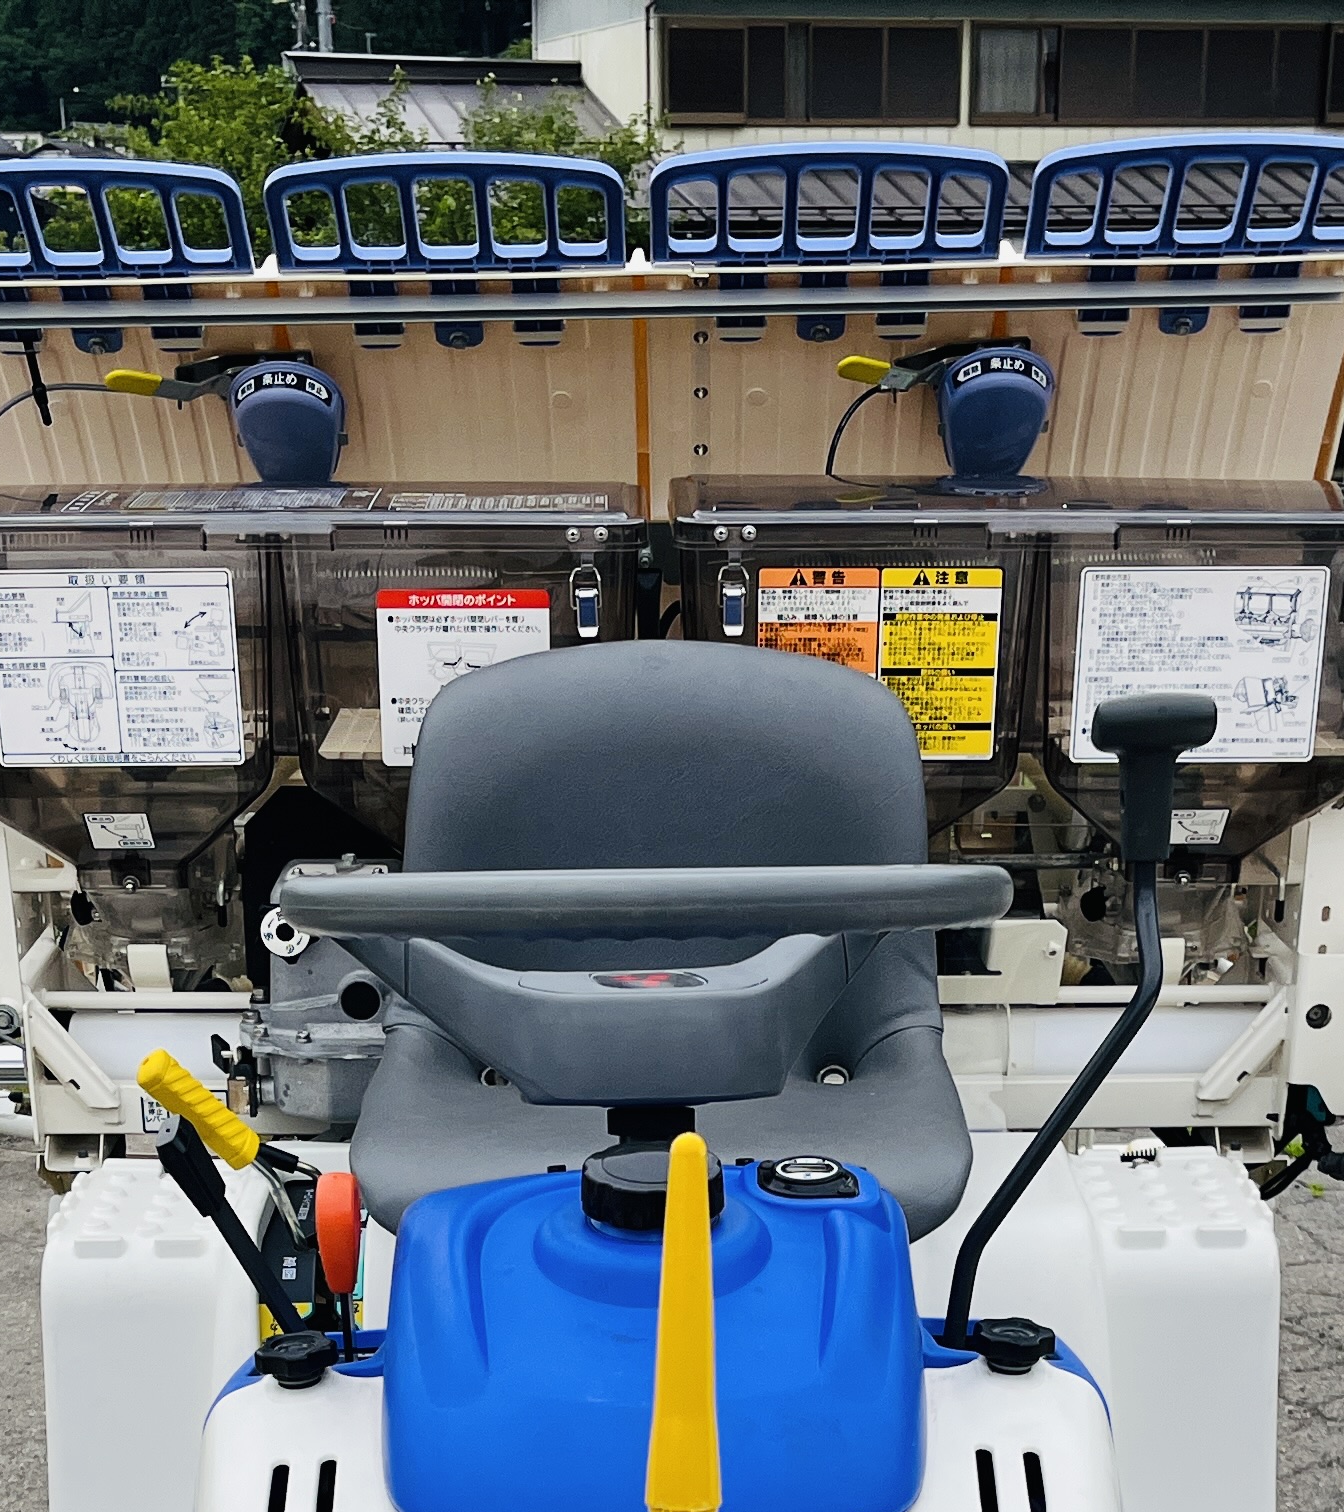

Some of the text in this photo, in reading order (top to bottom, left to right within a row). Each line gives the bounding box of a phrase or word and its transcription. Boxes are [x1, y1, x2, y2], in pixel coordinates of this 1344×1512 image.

[989, 357, 1025, 372] 条止め
[262, 372, 298, 386] 条止め
[67, 574, 146, 586] 取扱い要領
[812, 570, 846, 585] 警告
[935, 570, 969, 585] 注意
[408, 594, 517, 607] ホッパ開閉のポイント
[148, 1108, 163, 1116] 停止
[145, 1115, 167, 1123] レバー
